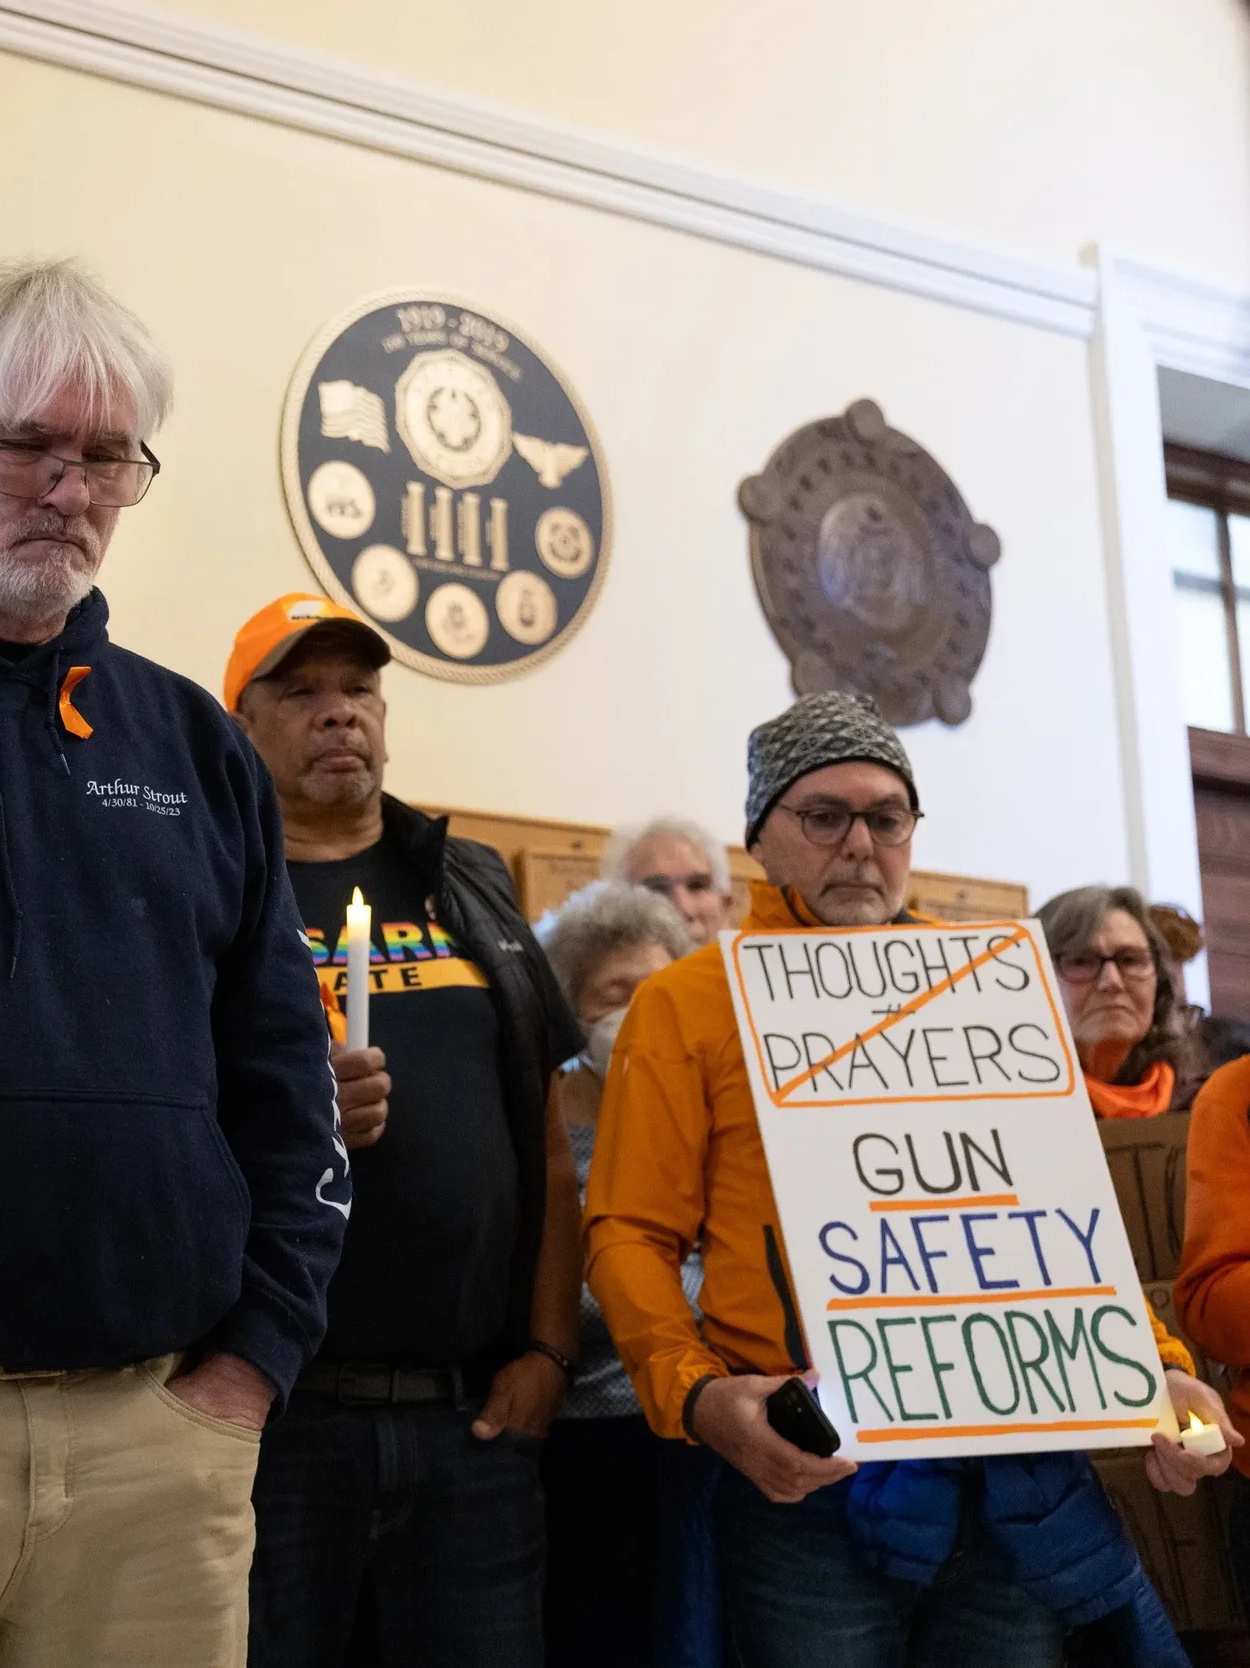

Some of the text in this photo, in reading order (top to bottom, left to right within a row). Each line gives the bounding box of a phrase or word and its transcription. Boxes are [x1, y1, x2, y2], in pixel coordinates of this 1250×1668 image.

[86, 779, 188, 804] Arthur Strout
[102, 798, 138, 807] 4/30/81
[146, 802, 180, 816] 10/25/23
[743, 936, 1031, 1001] THOUGHTS
[762, 1023, 1061, 1092] PRAYERS
[853, 1128, 1013, 1195] GUN
[818, 1208, 1101, 1295] SAFETY
[827, 1305, 1158, 1424] REFORMS
